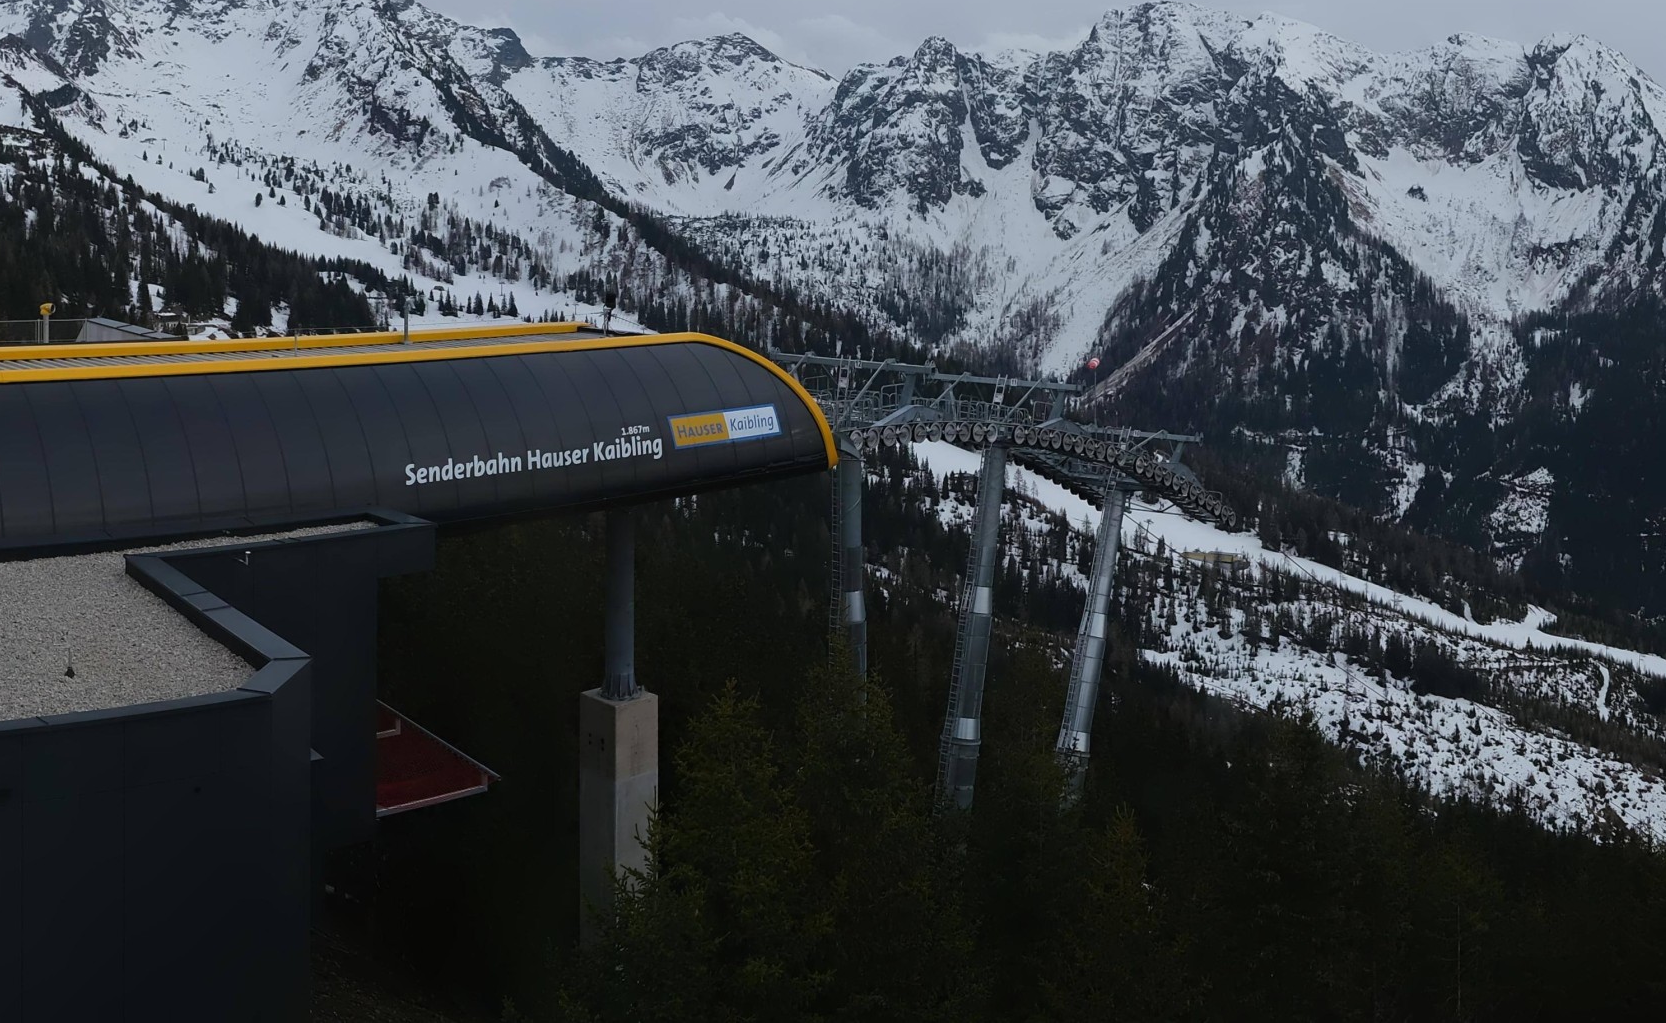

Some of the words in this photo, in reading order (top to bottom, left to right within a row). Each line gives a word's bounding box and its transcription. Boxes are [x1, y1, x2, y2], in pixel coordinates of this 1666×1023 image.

[621, 425, 650, 435] 1.867m
[677, 423, 723, 438] HAUSER
[730, 415, 774, 431] Kaibling
[405, 452, 522, 485] Senderbahn
[527, 448, 589, 470] Hauser
[593, 436, 663, 460] Kaibling
